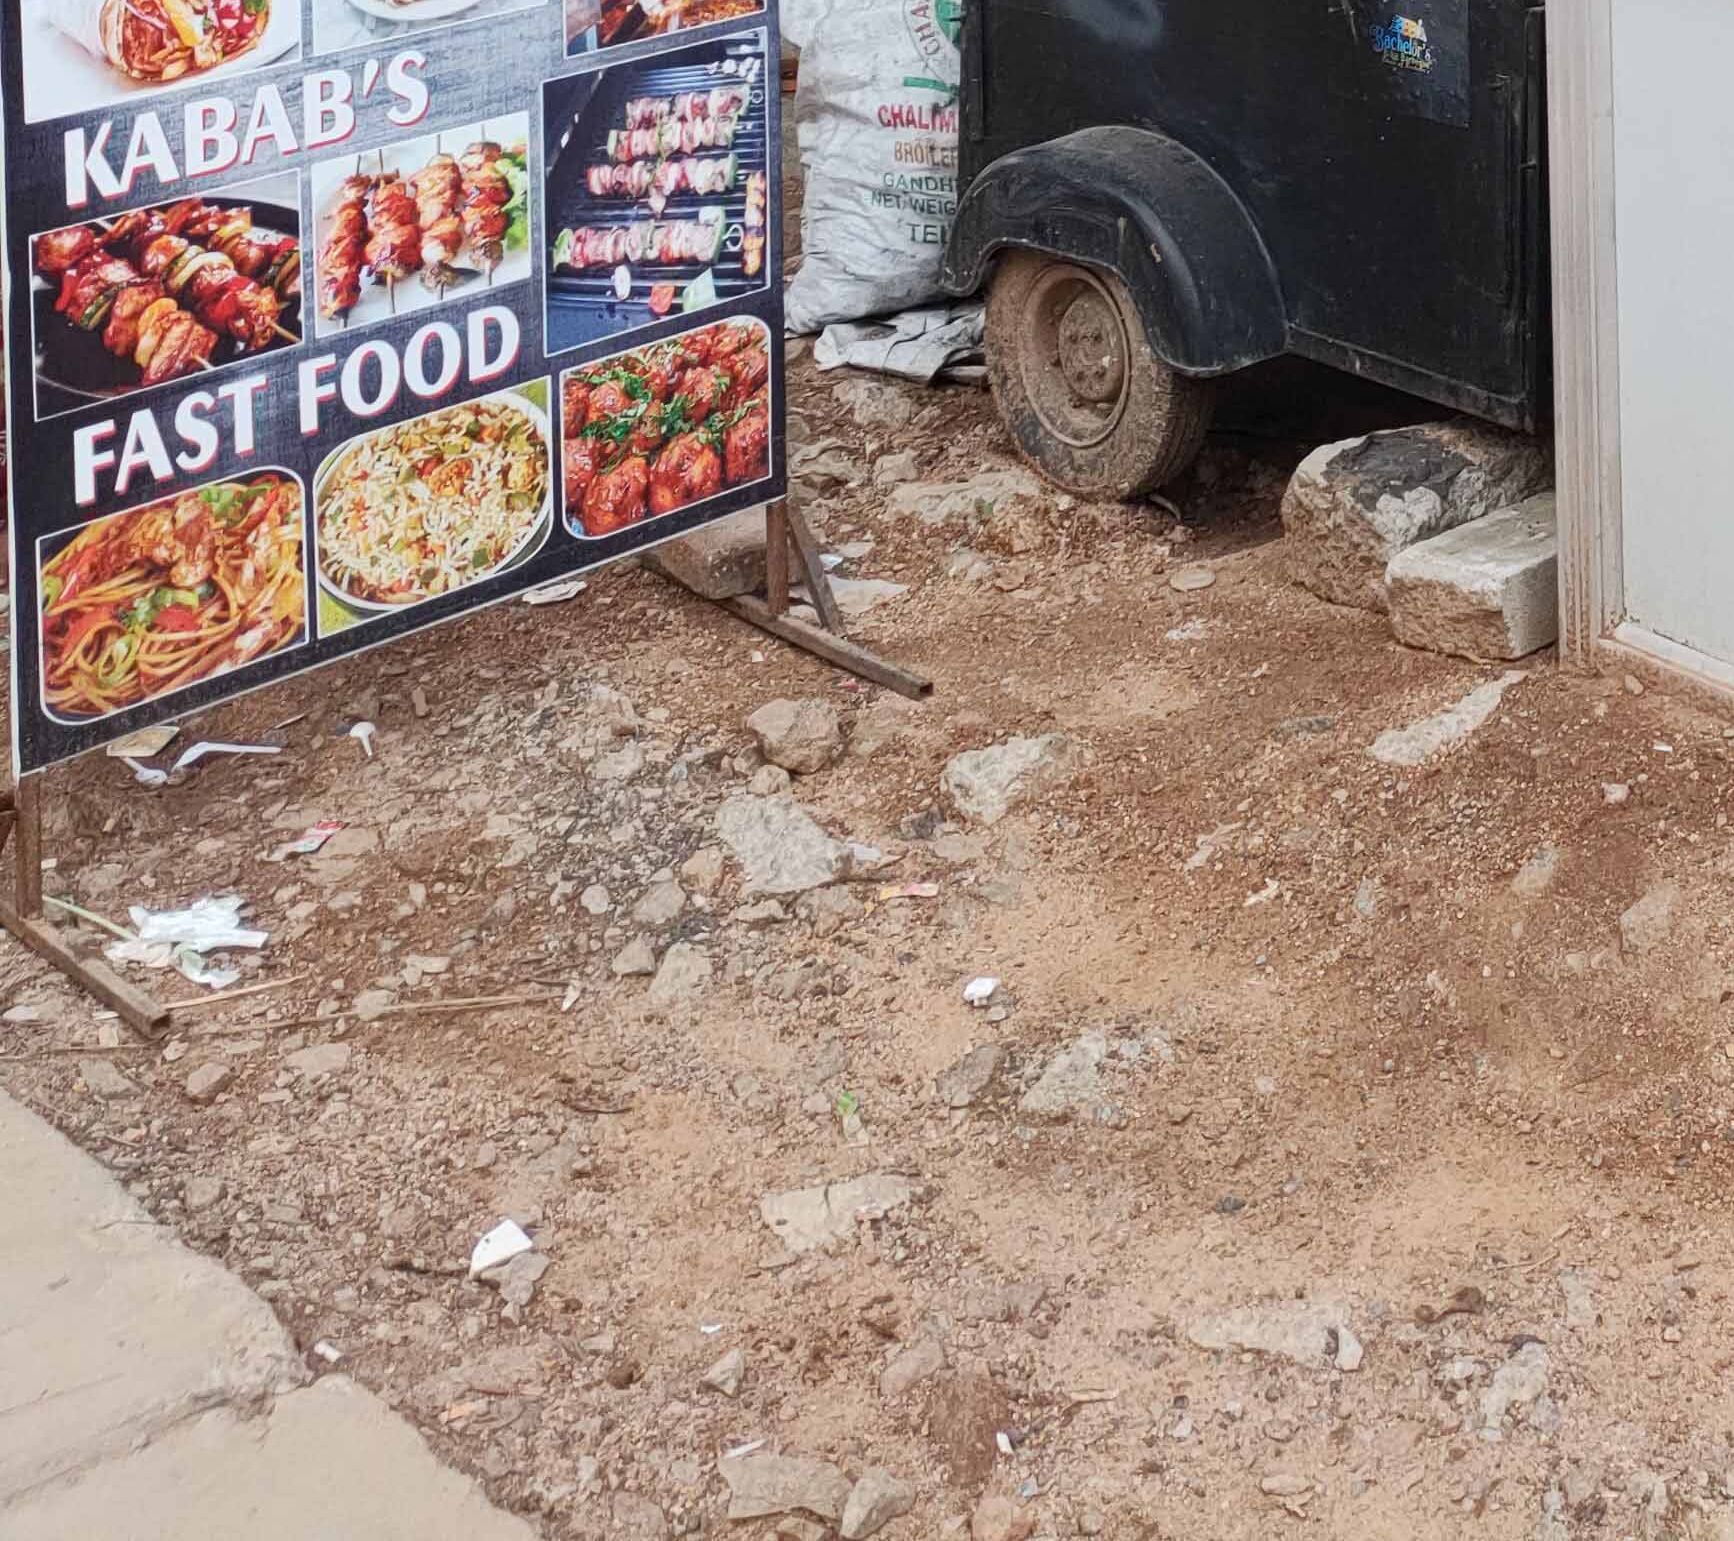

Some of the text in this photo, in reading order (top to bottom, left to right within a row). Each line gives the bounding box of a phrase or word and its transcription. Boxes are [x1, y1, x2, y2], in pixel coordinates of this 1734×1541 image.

[64, 51, 431, 206] KABAB'S
[73, 305, 521, 505] FAST FOOD
